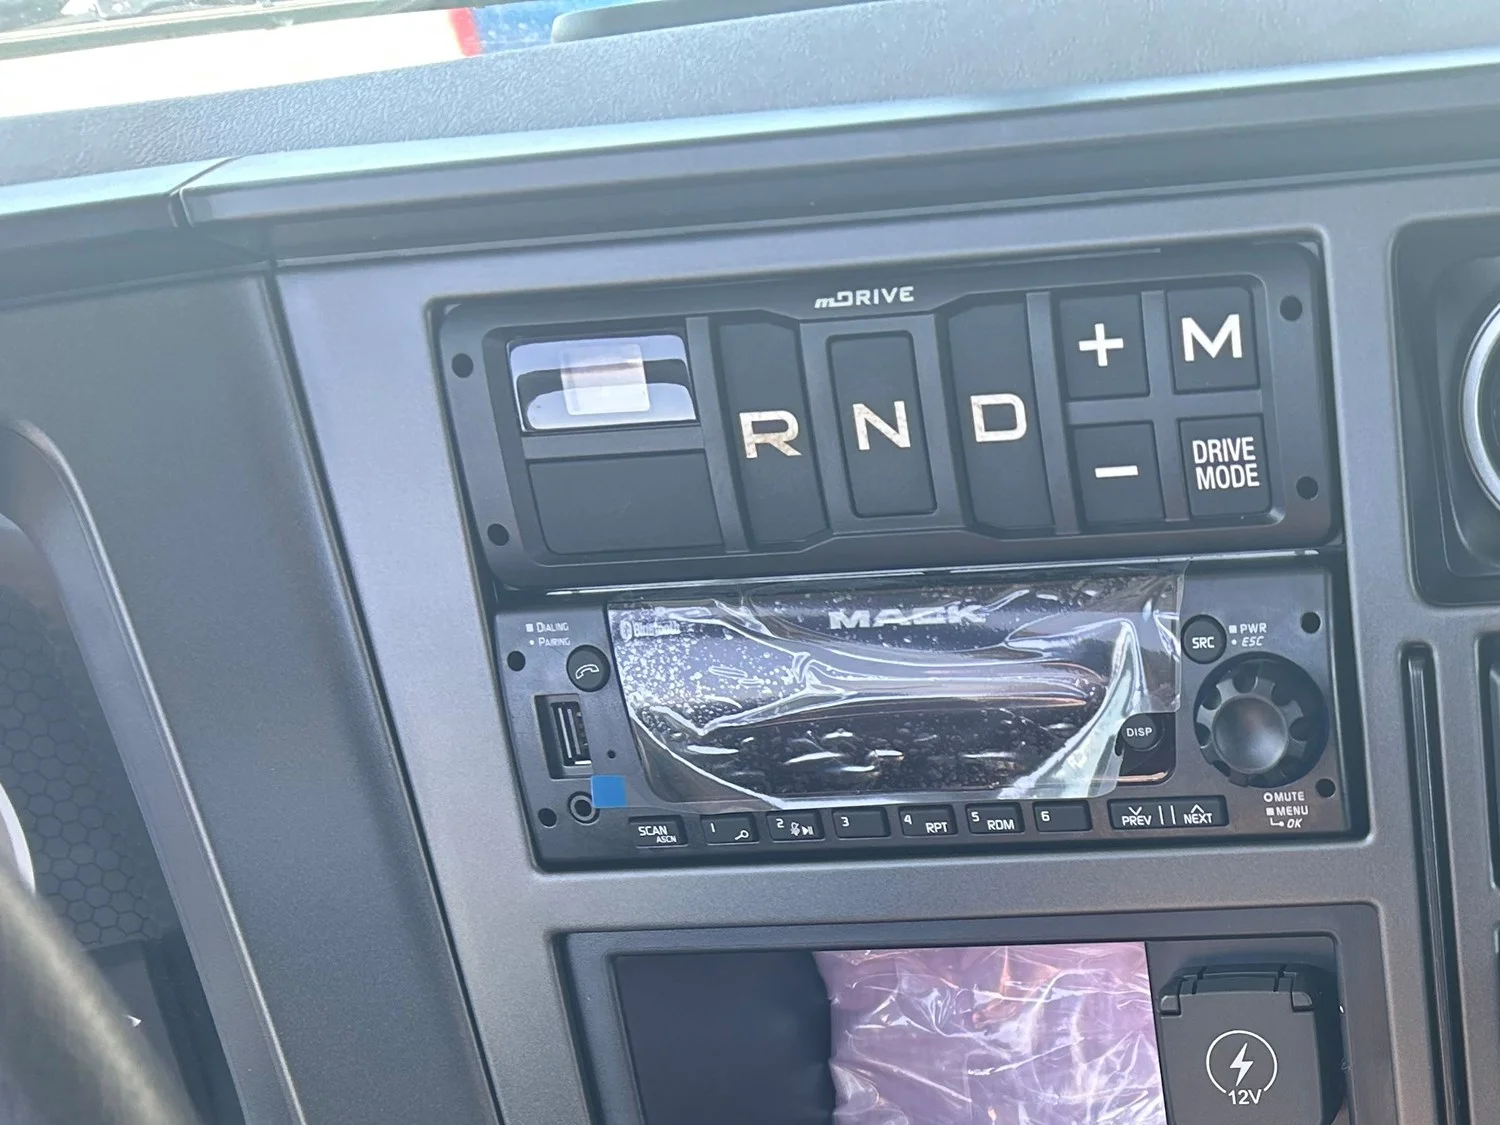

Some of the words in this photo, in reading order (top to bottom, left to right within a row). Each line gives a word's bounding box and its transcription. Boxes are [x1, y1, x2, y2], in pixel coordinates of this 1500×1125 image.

[1181, 313, 1243, 362] M
[970, 393, 1027, 442] D
[852, 400, 911, 451] N
[739, 410, 802, 459] R
[1192, 436, 1256, 464] DRIVE
[1195, 463, 1260, 490] MODE
[828, 605, 986, 630] MACK
[1240, 623, 1267, 634] PWR
[1192, 636, 1215, 649] SRC
[1241, 636, 1264, 647] ESC
[1126, 727, 1153, 737] DISP
[1274, 792, 1305, 802] MUTE
[1040, 810, 1051, 822] 6
[1276, 805, 1309, 816] MENU
[840, 816, 850, 827] 3
[903, 814, 913, 825] 4
[971, 811, 980, 822] 5
[1121, 815, 1152, 826] PREV
[1183, 812, 1213, 824] NEXT
[710, 822, 716, 833] 1
[775, 818, 785, 828] 2
[925, 821, 949, 834] RPT
[987, 819, 1015, 831] RDM
[1286, 818, 1303, 829] OK
[638, 825, 668, 836] SCAN
[656, 835, 677, 844] ASCN
[1228, 1089, 1262, 1105] 12V
